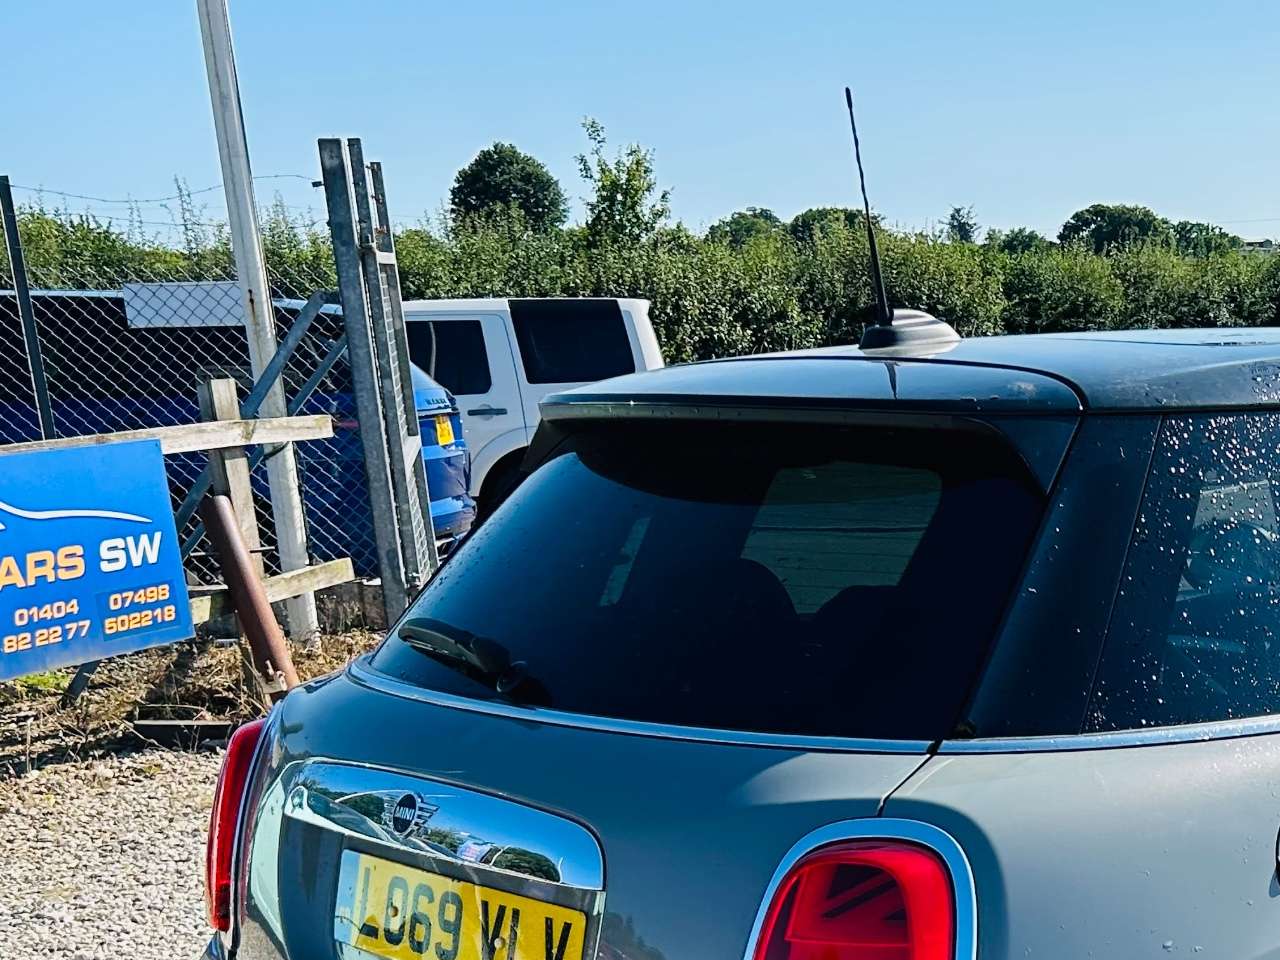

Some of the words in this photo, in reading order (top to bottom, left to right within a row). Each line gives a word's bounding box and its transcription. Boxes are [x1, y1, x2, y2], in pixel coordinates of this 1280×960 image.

[99, 531, 162, 573] SW
[109, 584, 170, 611] 07498
[14, 598, 80, 627] 01404
[3, 632, 32, 654] 82
[35, 626, 63, 647] 22
[65, 619, 91, 640] 77
[394, 805, 416, 821] MINI
